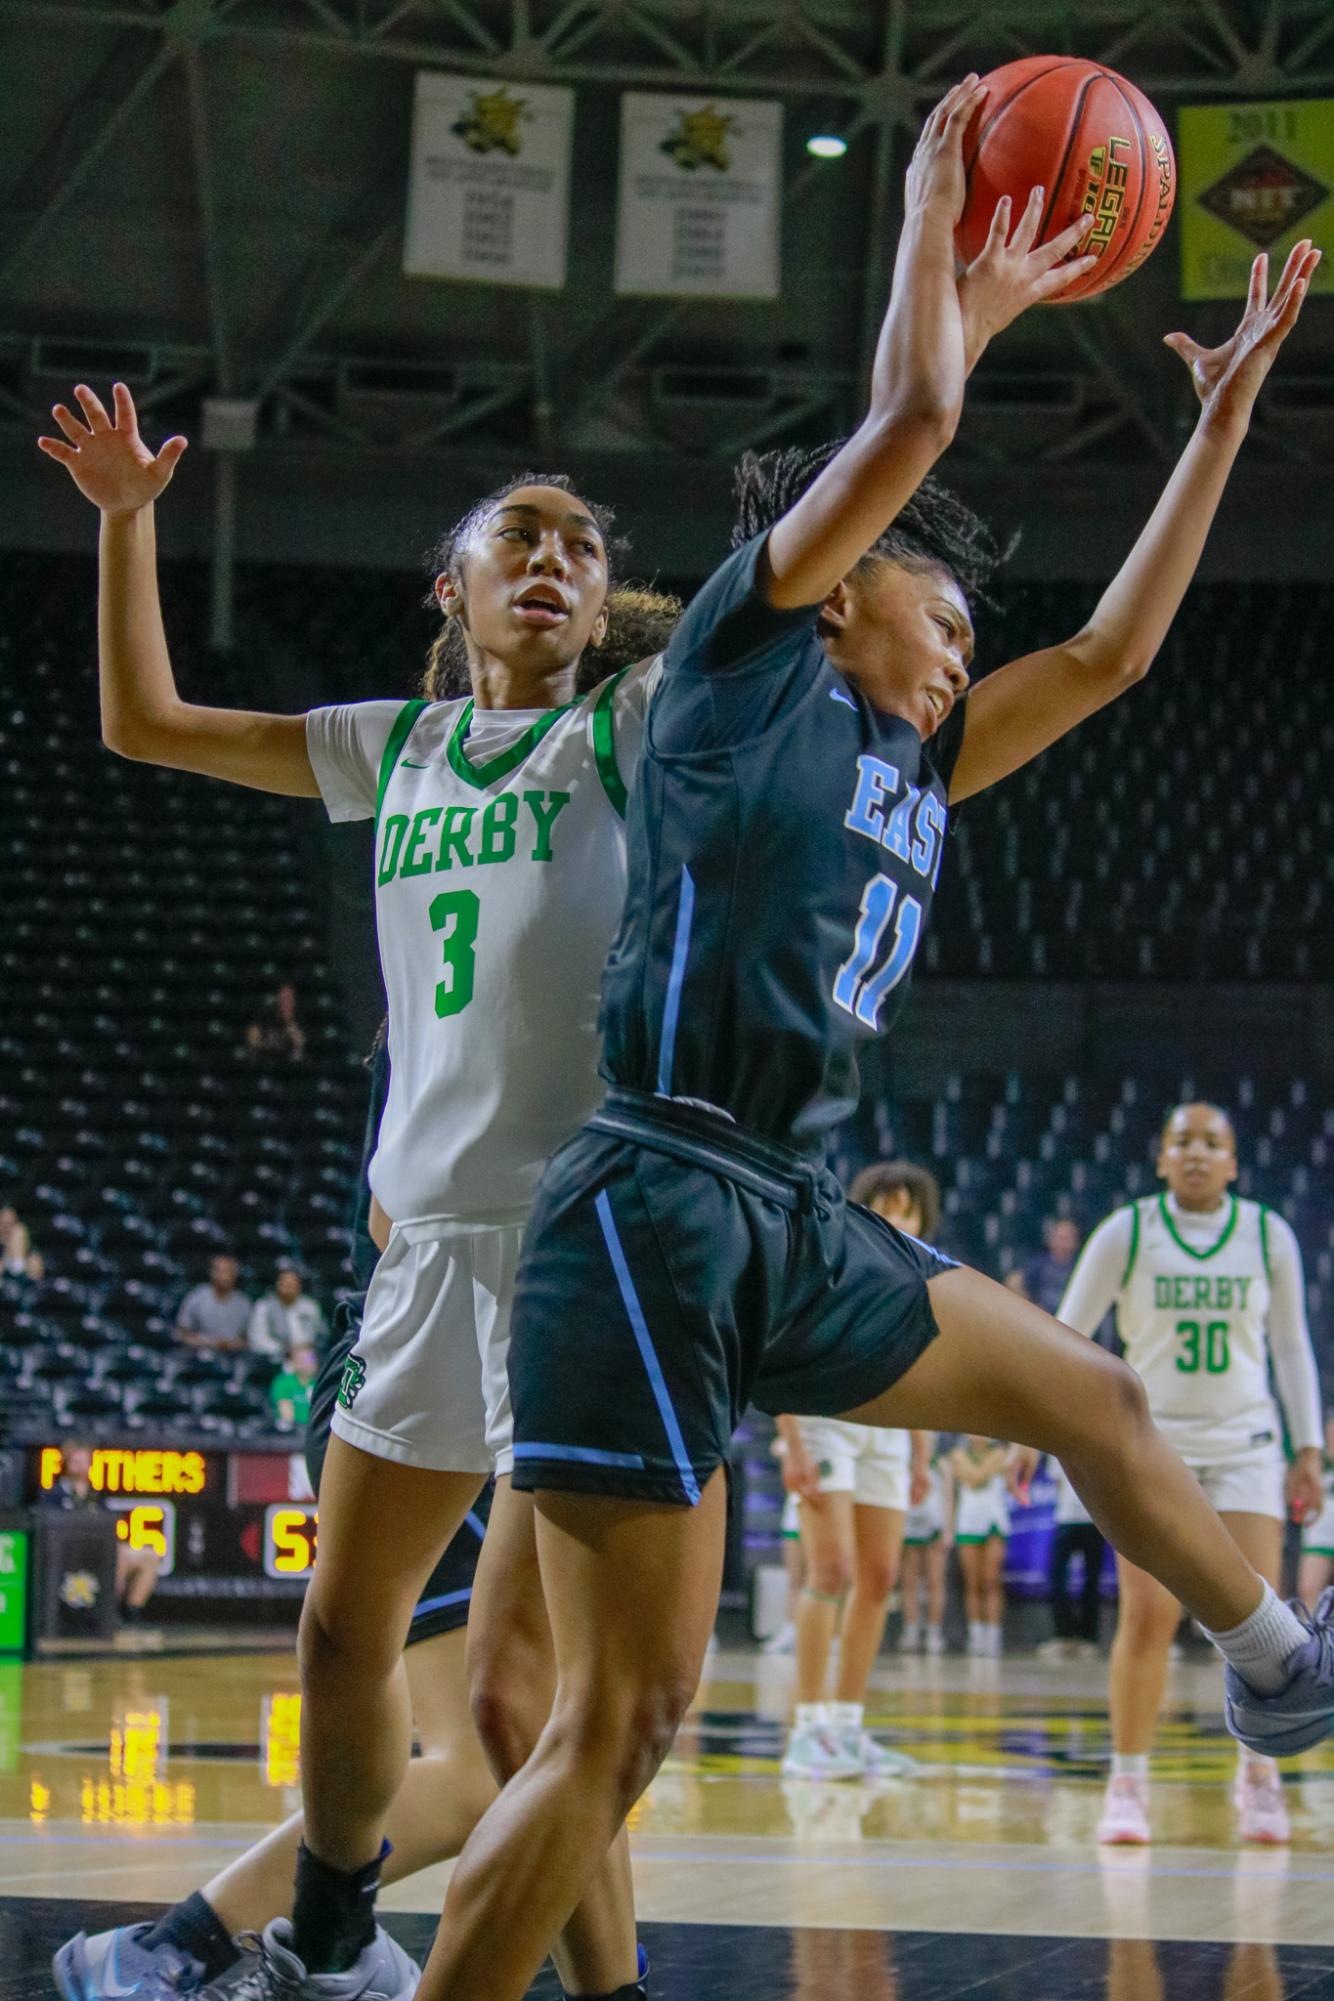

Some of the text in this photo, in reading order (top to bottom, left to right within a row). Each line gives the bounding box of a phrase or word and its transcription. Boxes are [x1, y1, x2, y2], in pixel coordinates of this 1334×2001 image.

[1083, 135, 1131, 259] LEGAC
[378, 790, 571, 888] DERBY
[428, 889, 480, 1019] 3
[833, 872, 922, 1032] 11
[1154, 1275, 1252, 1311] DERBY
[1175, 1320, 1230, 1374] 30
